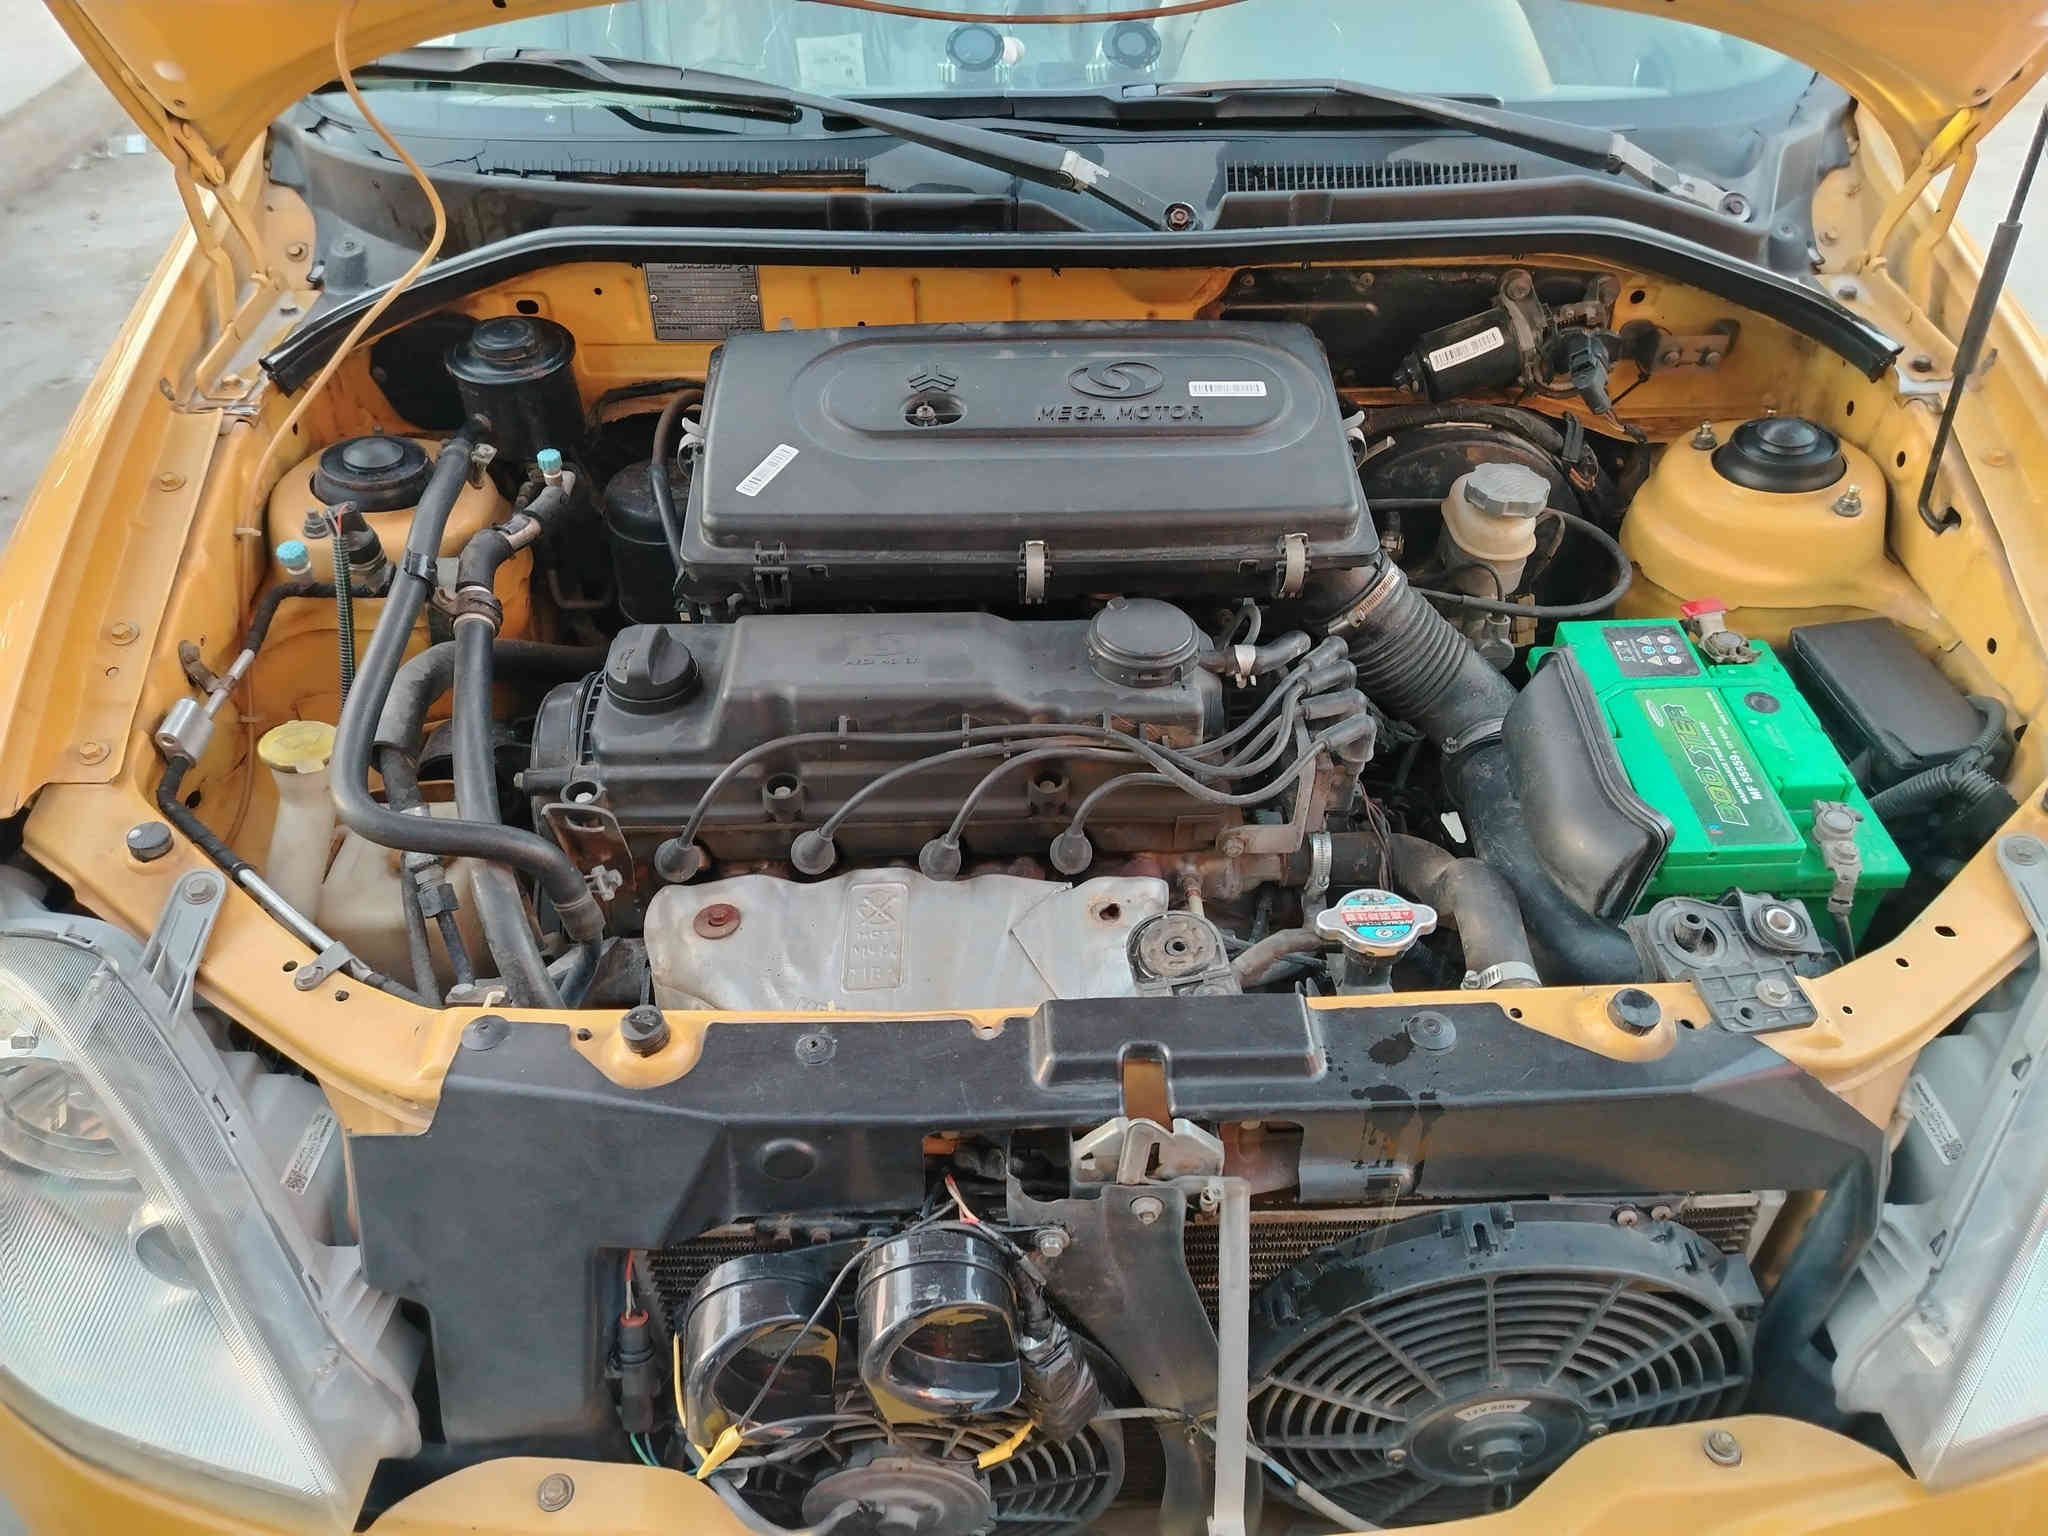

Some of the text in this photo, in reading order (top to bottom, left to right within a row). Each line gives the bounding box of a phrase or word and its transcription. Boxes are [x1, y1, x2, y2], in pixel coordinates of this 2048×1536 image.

[1037, 405, 1204, 422] MEGA MOTOR
[1661, 703, 1750, 826] BOOSTER
[1744, 784, 1764, 800] MF
